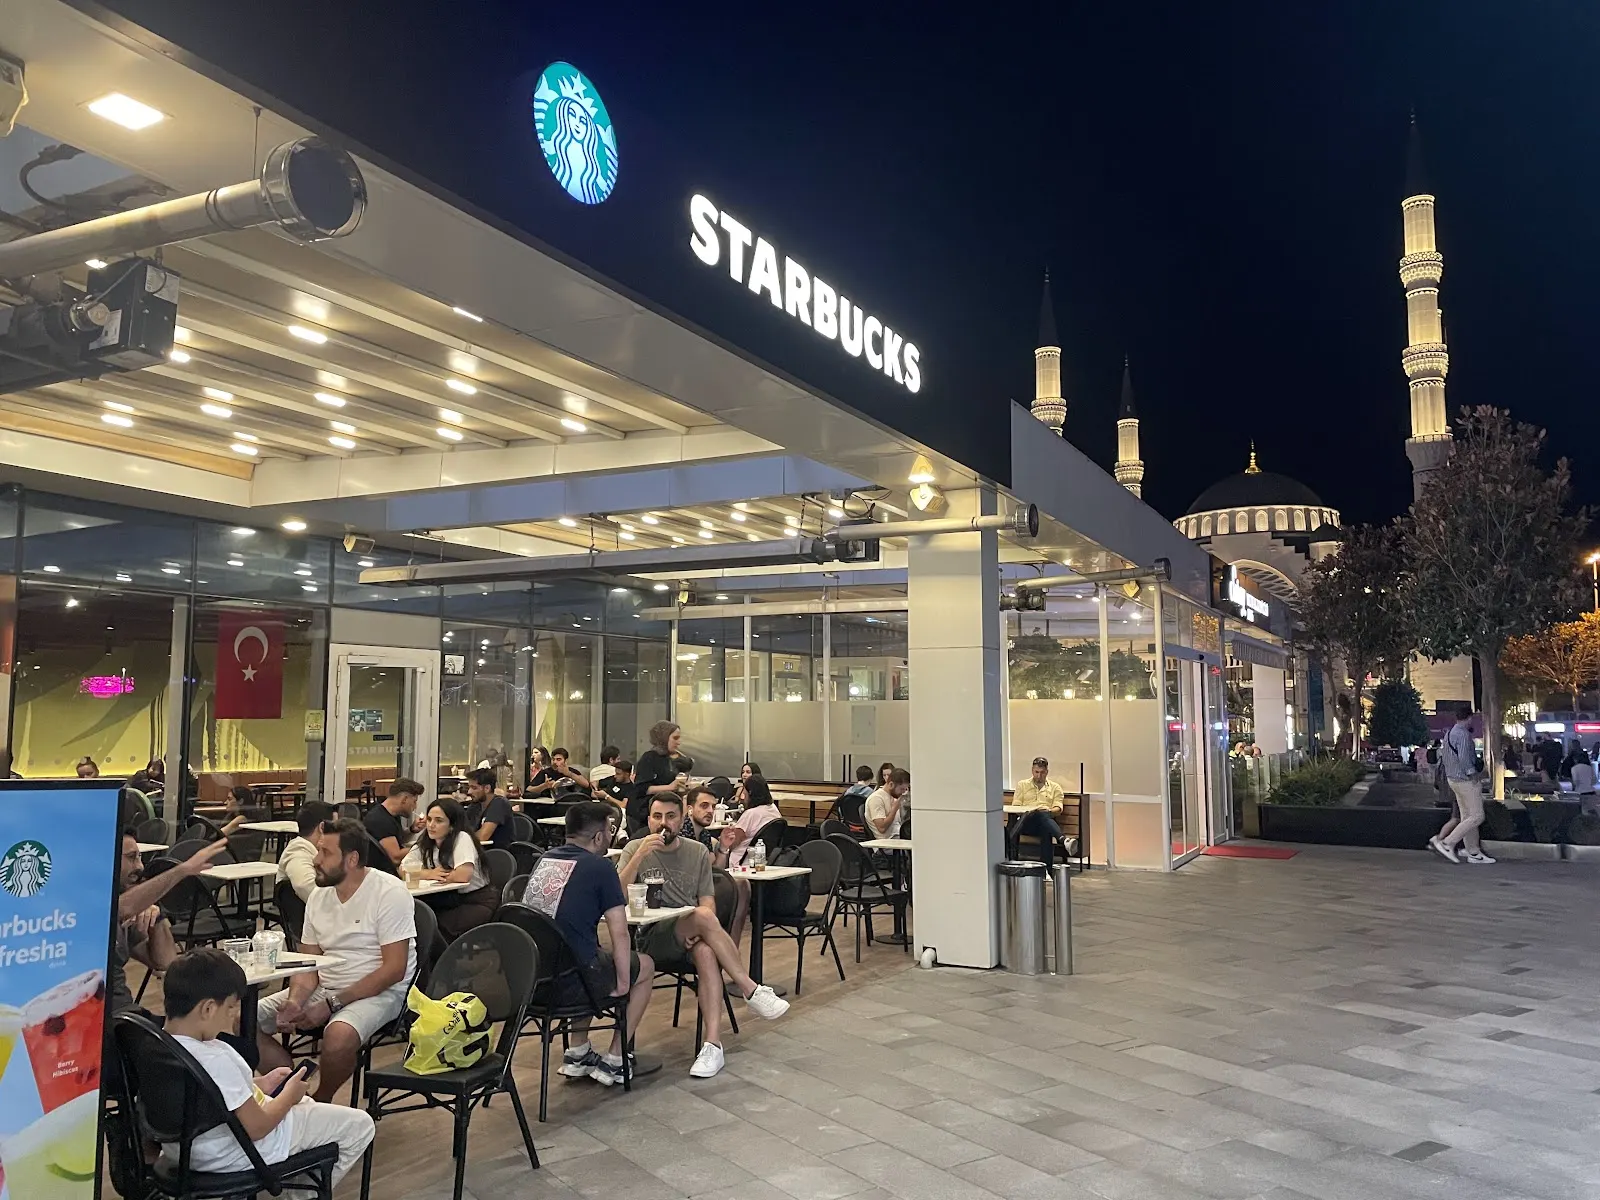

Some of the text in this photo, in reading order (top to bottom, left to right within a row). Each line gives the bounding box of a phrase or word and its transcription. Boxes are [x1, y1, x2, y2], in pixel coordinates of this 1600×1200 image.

[690, 193, 921, 393] STARBUCKS
[348, 745, 413, 755] STARBUCKS
[0, 908, 77, 938] rbucks
